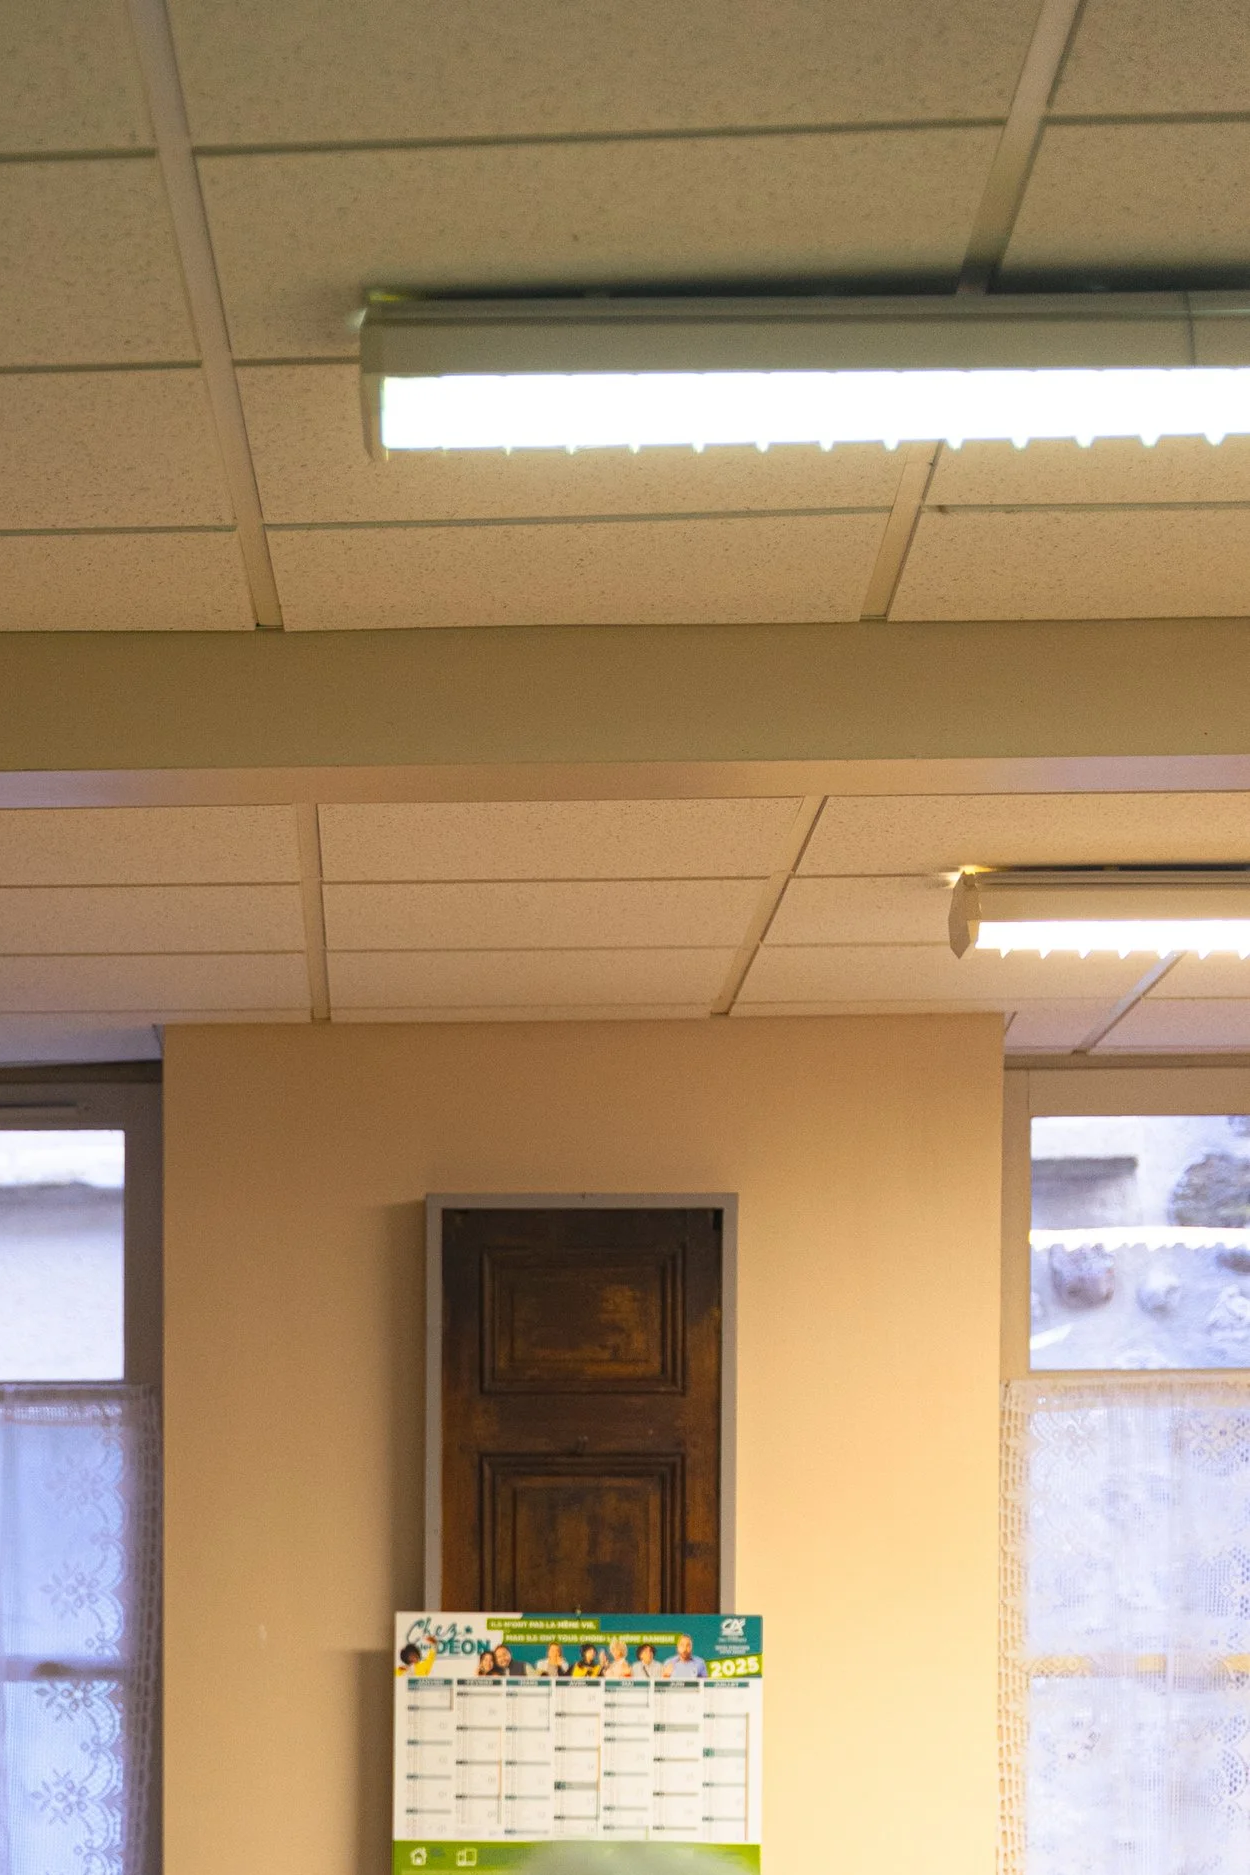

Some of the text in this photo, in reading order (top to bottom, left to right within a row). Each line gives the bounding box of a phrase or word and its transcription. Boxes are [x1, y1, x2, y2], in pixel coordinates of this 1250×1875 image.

[407, 1616, 457, 1643] Chez
[546, 1621, 556, 1629] LA
[710, 1656, 760, 1678] 2025
